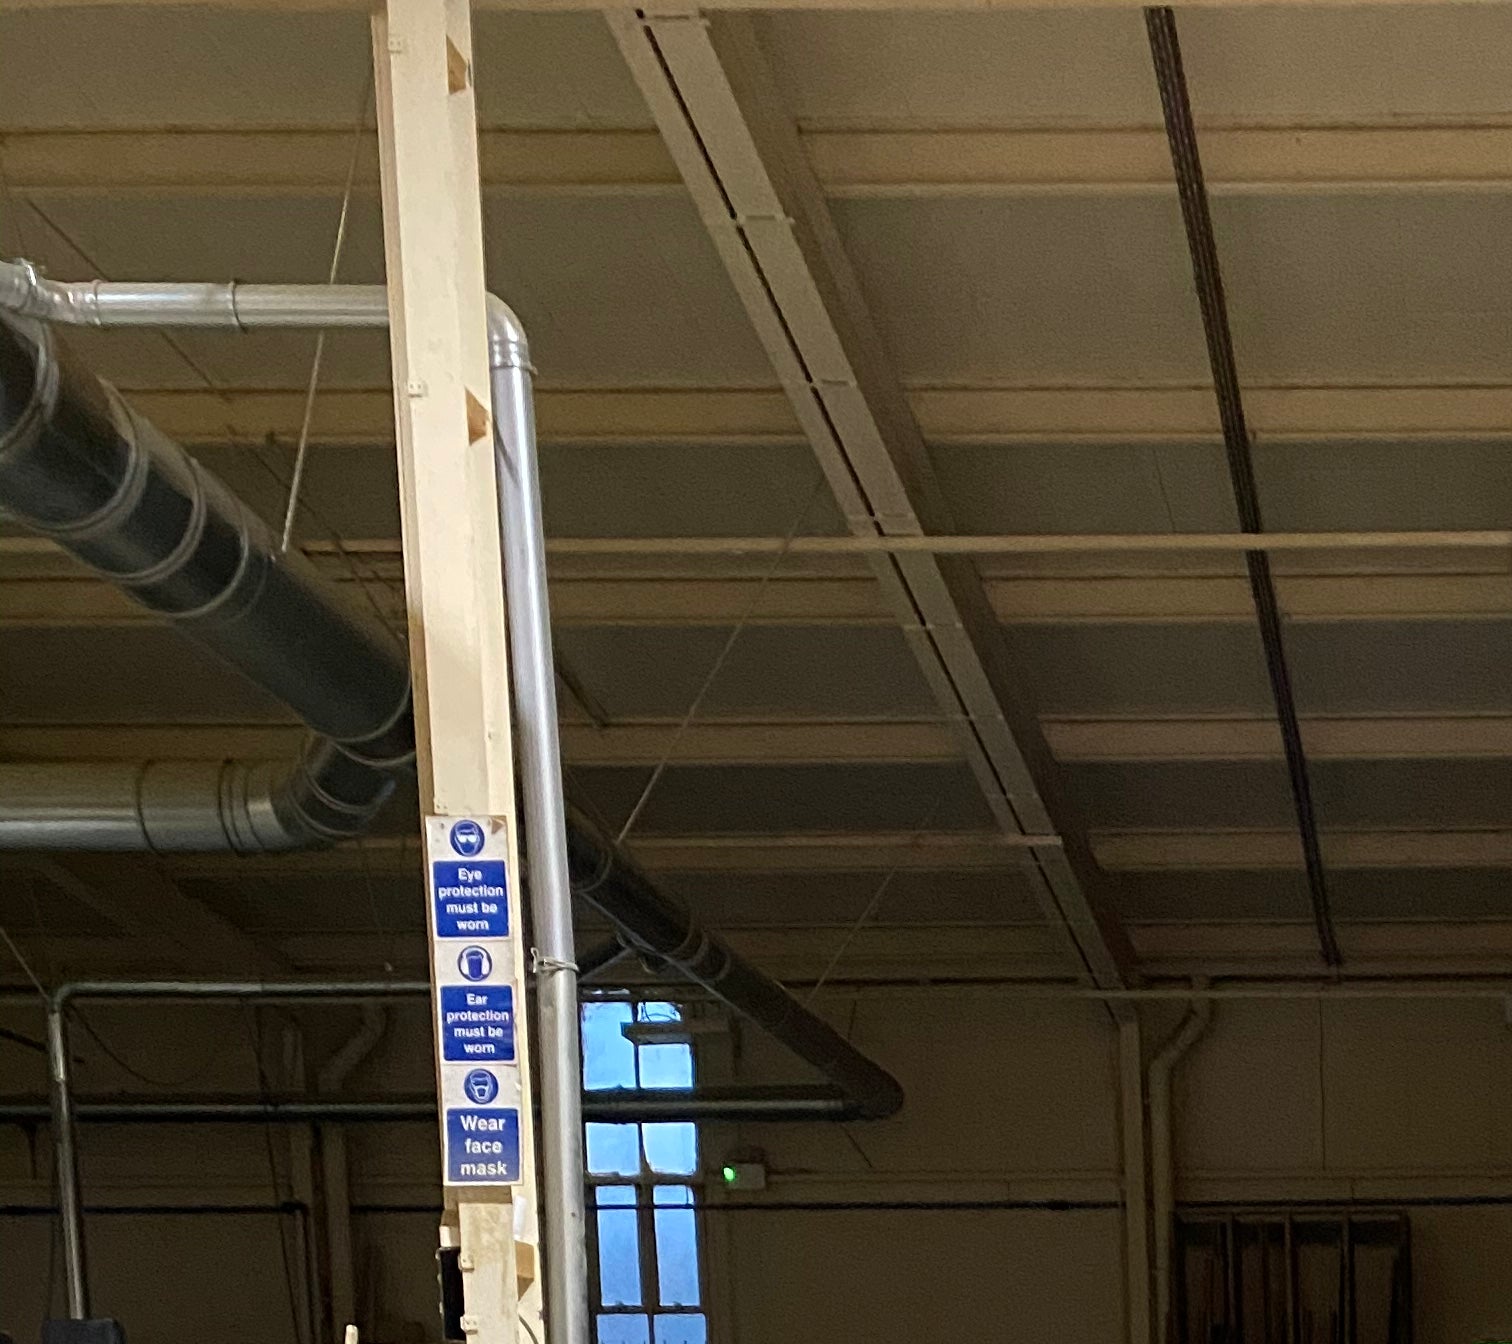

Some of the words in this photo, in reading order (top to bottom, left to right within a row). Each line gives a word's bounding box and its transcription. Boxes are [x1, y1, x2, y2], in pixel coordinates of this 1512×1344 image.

[458, 868, 482, 882] Eye
[438, 885, 503, 900] protection
[446, 902, 478, 914] must
[481, 902, 498, 914] be
[457, 919, 489, 931] worn
[466, 993, 488, 1006] Ear
[446, 1010, 509, 1024] protection
[454, 1026, 485, 1038] must
[488, 1026, 503, 1038] be
[464, 1043, 495, 1054] worn
[460, 1115, 506, 1131] Wear
[465, 1138, 502, 1153] face
[460, 1160, 507, 1176] mask
